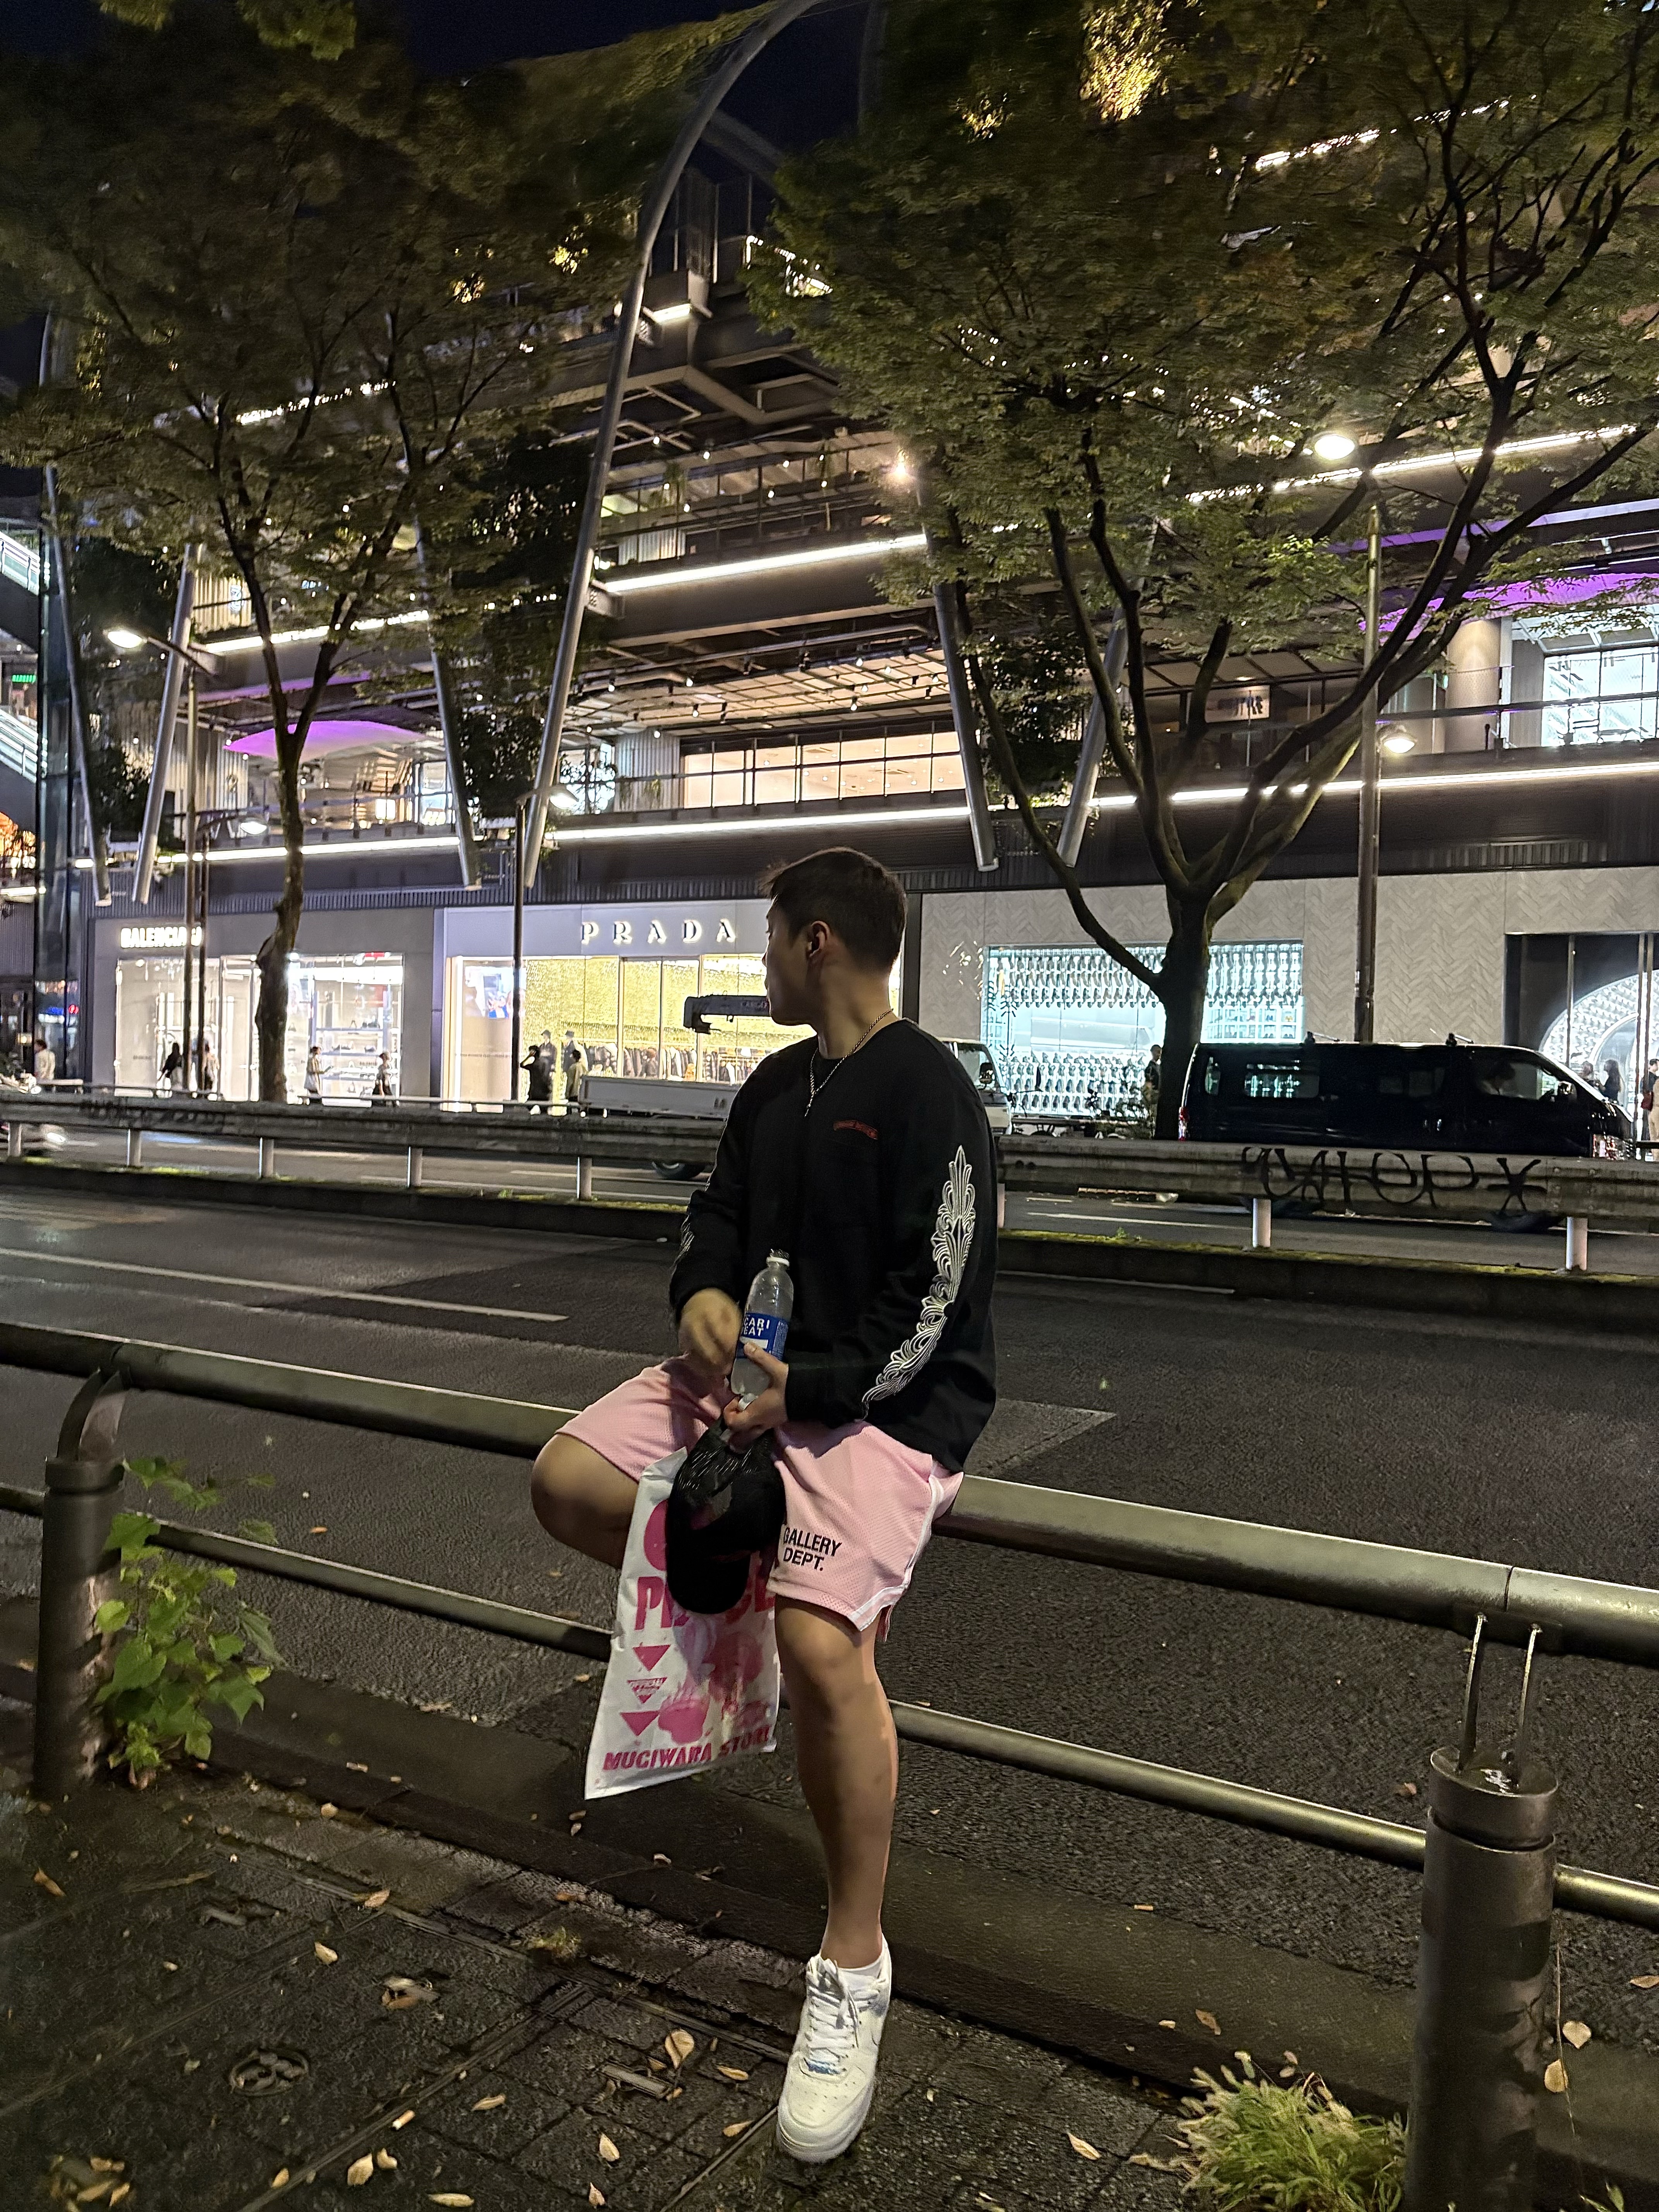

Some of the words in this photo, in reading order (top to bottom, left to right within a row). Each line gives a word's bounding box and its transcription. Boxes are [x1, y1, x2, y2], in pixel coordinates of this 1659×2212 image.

[581, 919, 736, 945] PRADA
[783, 1527, 842, 1556] GALLERY
[783, 1547, 824, 1571] DEPT.
[603, 1743, 711, 1771] MUGIWARA
